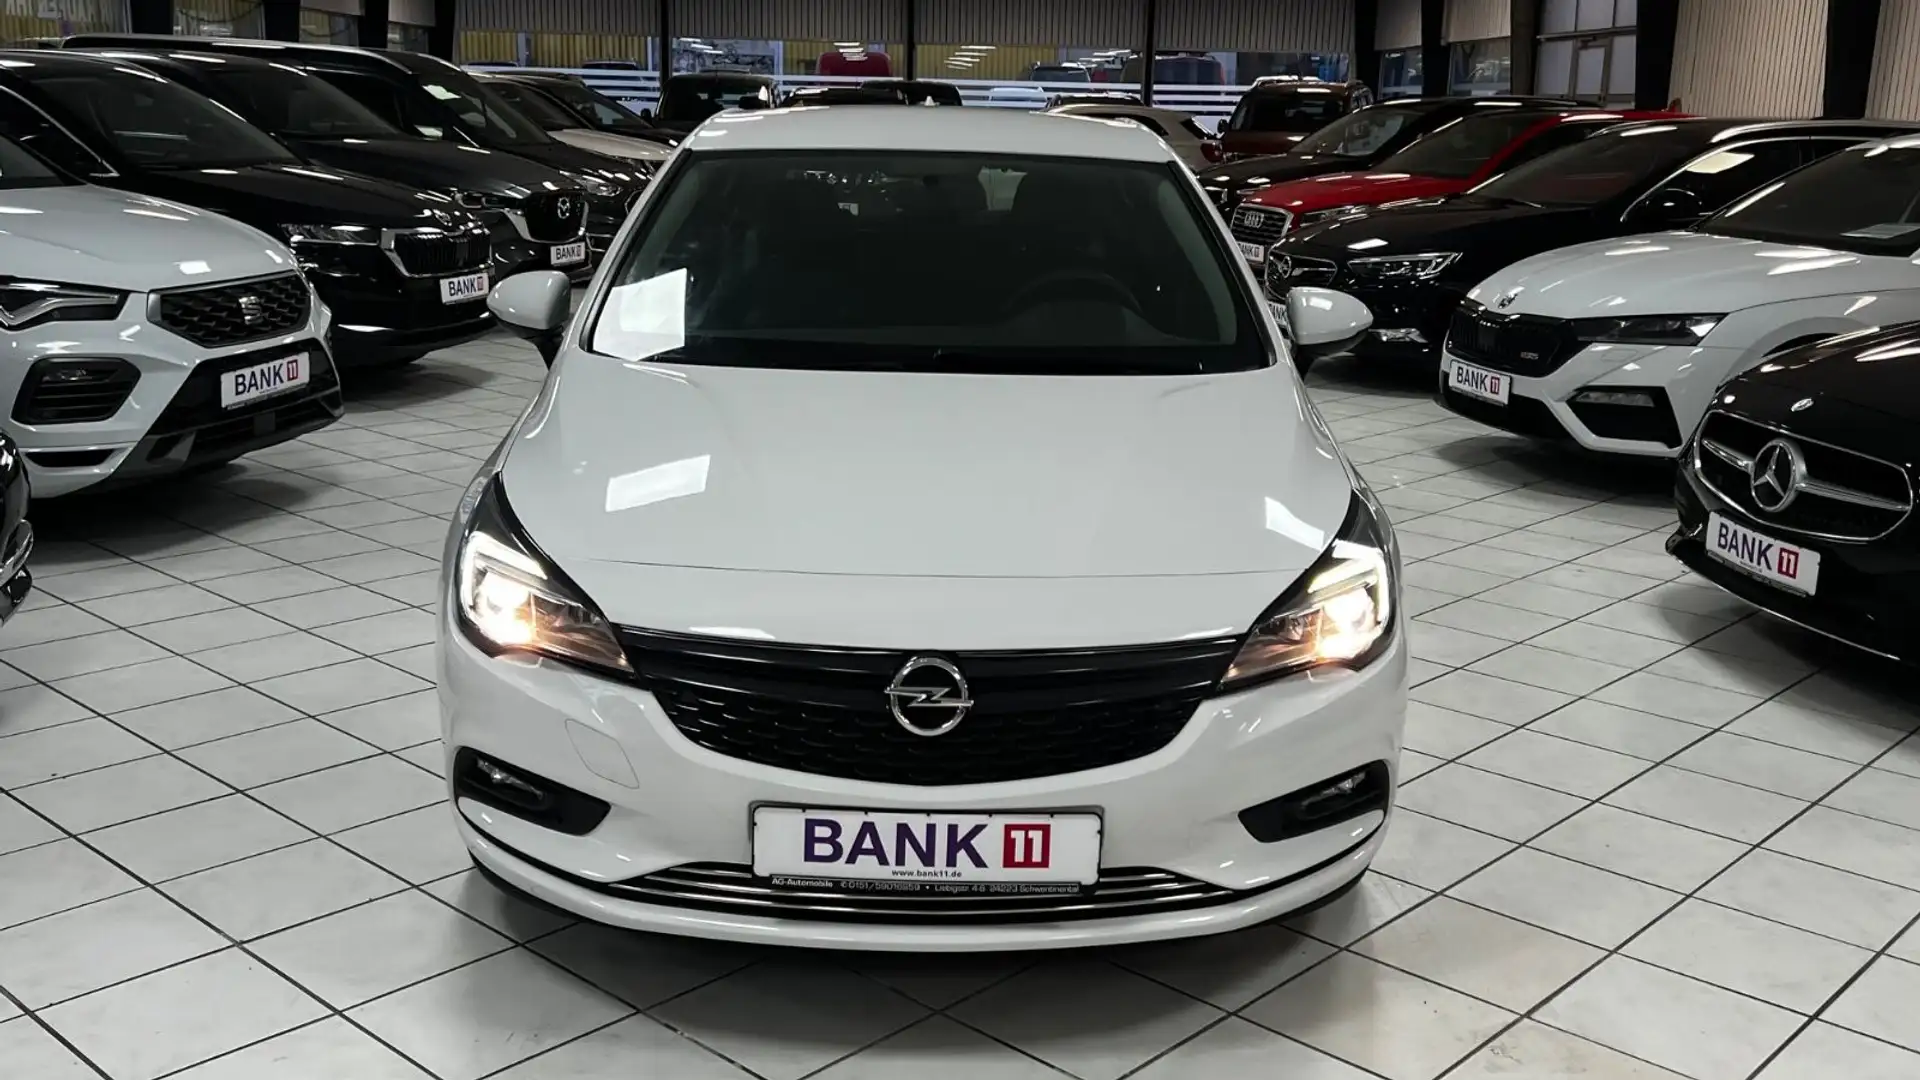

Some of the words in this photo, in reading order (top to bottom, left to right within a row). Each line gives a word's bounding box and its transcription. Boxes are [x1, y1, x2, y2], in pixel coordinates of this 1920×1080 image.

[448, 277, 477, 297] BANK
[235, 363, 284, 396] BANK
[287, 360, 299, 381] 11
[1457, 366, 1488, 392] BANK
[1491, 376, 1500, 395] 11
[1718, 522, 1774, 571] BANK
[1779, 549, 1798, 578] 11
[803, 818, 990, 868] BANK
[1007, 827, 1047, 865] 11
[891, 868, 962, 879] www.bank11.de
